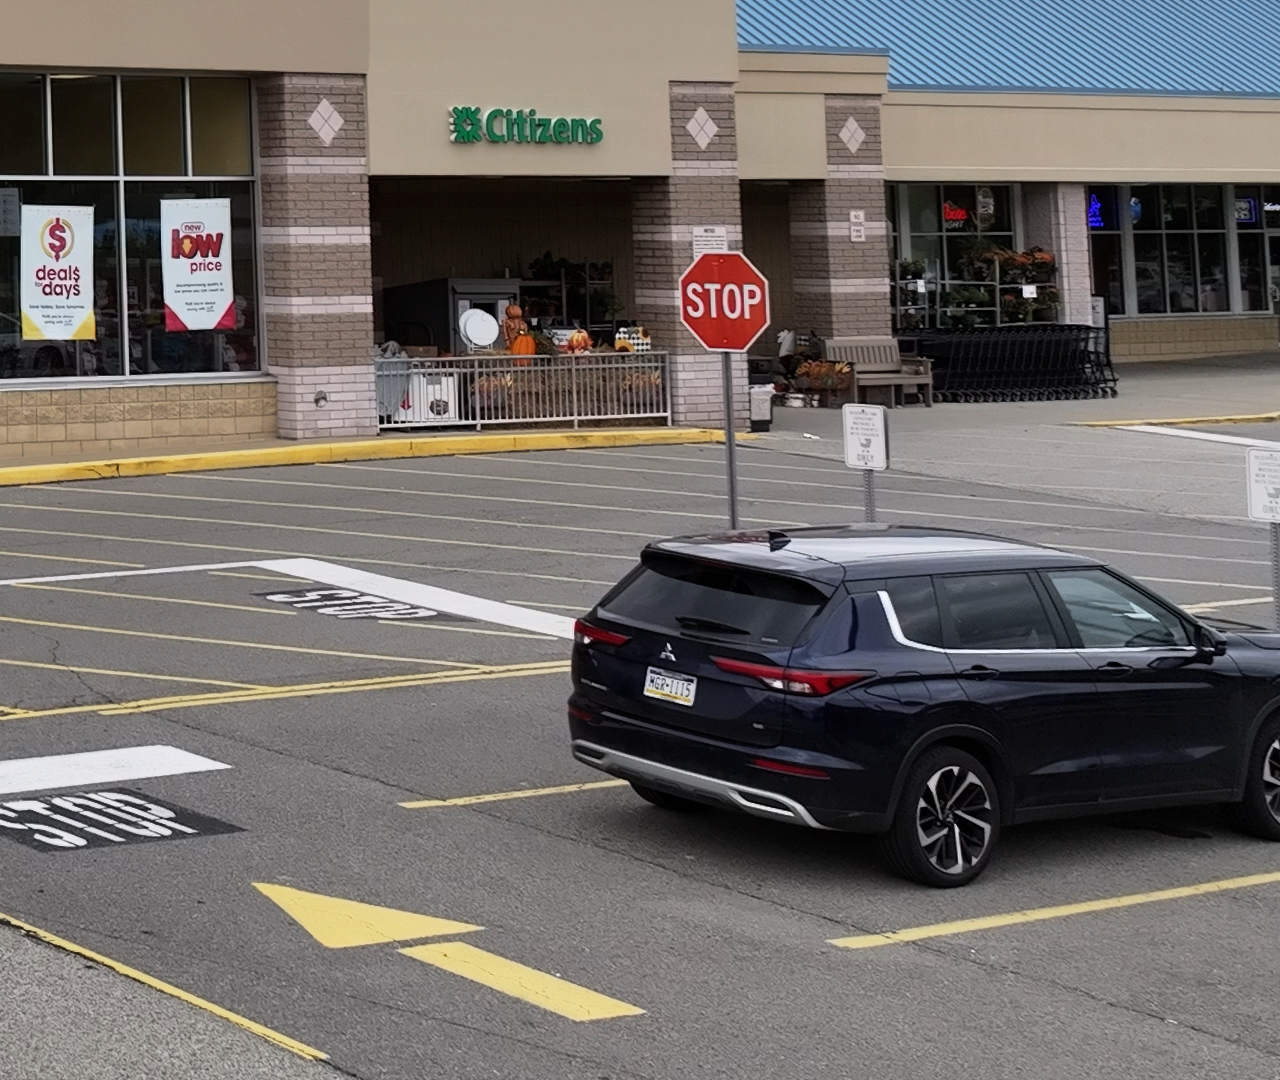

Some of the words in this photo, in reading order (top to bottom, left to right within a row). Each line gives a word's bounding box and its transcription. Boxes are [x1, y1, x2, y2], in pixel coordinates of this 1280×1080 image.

[483, 108, 603, 143] Citizens
[184, 224, 202, 232] new
[171, 228, 224, 259] low
[190, 259, 222, 275] price
[41, 281, 81, 300] days
[686, 282, 762, 320] STOP
[856, 453, 874, 463] ONLY
